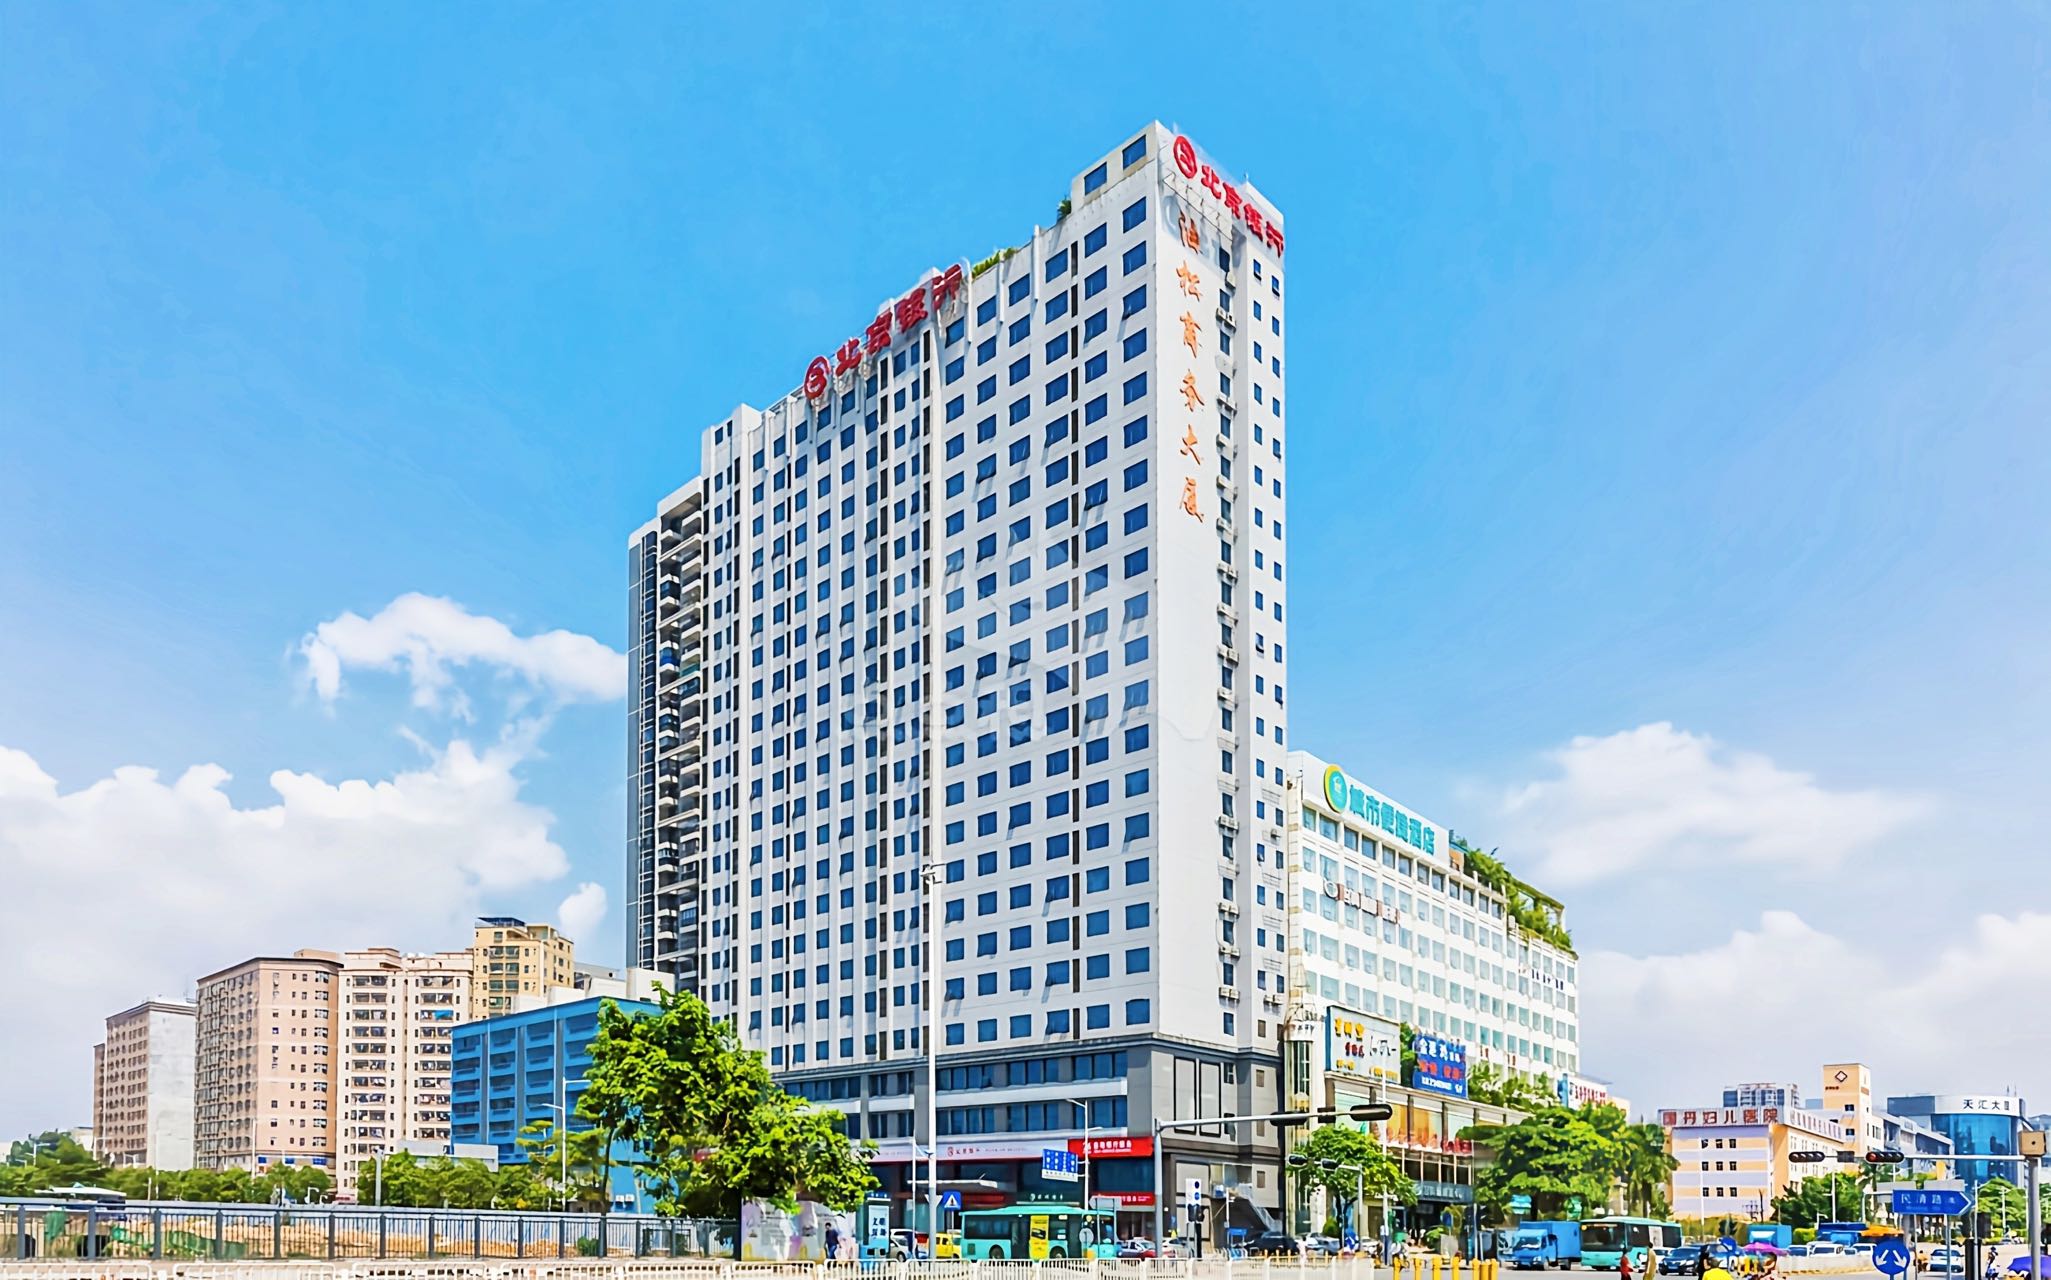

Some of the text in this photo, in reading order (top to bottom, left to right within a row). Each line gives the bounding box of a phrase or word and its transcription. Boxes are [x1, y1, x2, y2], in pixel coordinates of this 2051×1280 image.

[1201, 165, 1284, 258] 北京银行
[835, 264, 962, 376] 北京银行
